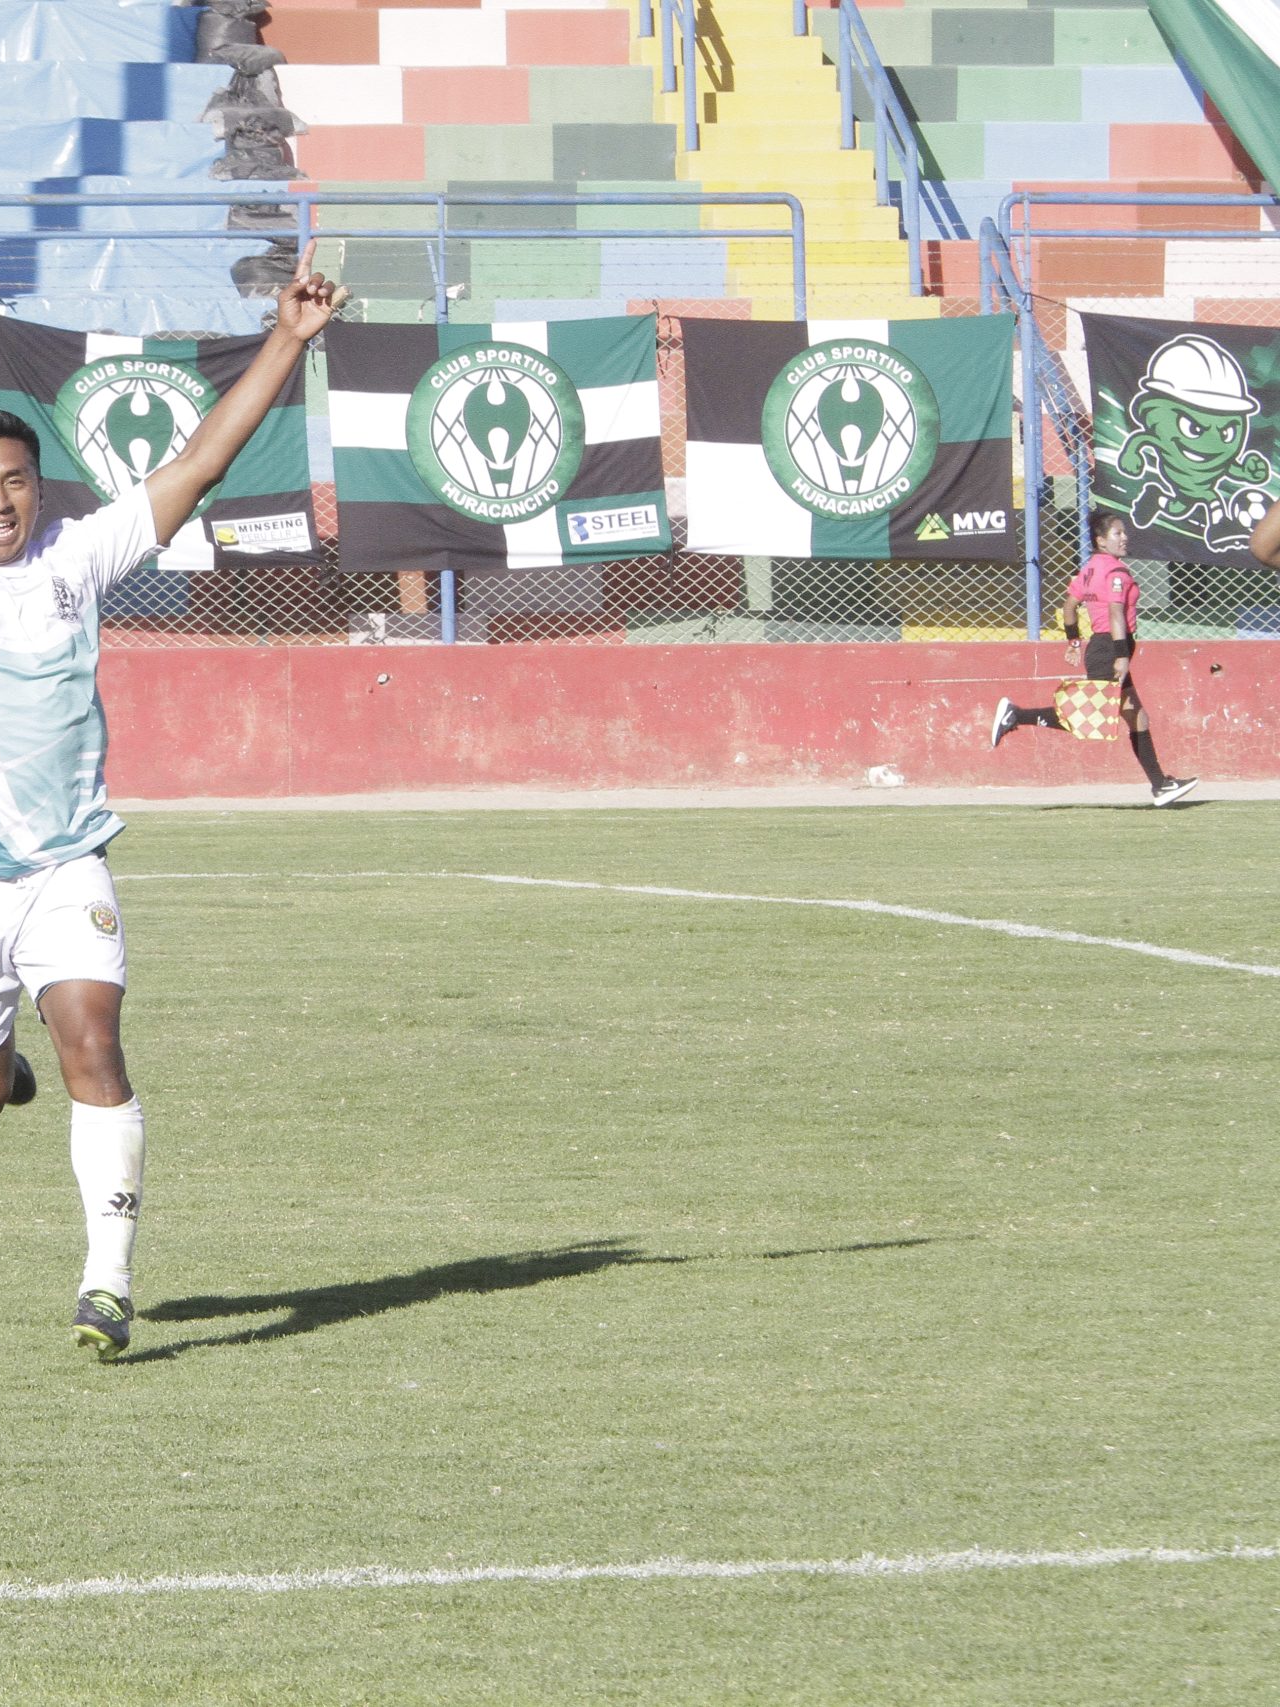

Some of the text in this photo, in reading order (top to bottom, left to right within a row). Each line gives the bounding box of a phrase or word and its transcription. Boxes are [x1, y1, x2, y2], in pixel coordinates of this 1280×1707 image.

[74, 360, 205, 398] CLUB SPORTIVO
[430, 350, 558, 389] CLUB SPORTIVO
[786, 347, 913, 385] CLUB SPORTIVO
[440, 479, 560, 519] HURACANCITO
[791, 476, 911, 515] HURACANCITO
[238, 518, 304, 533] MINSEING
[591, 510, 656, 530] STEEL
[952, 510, 1006, 531] MVG
